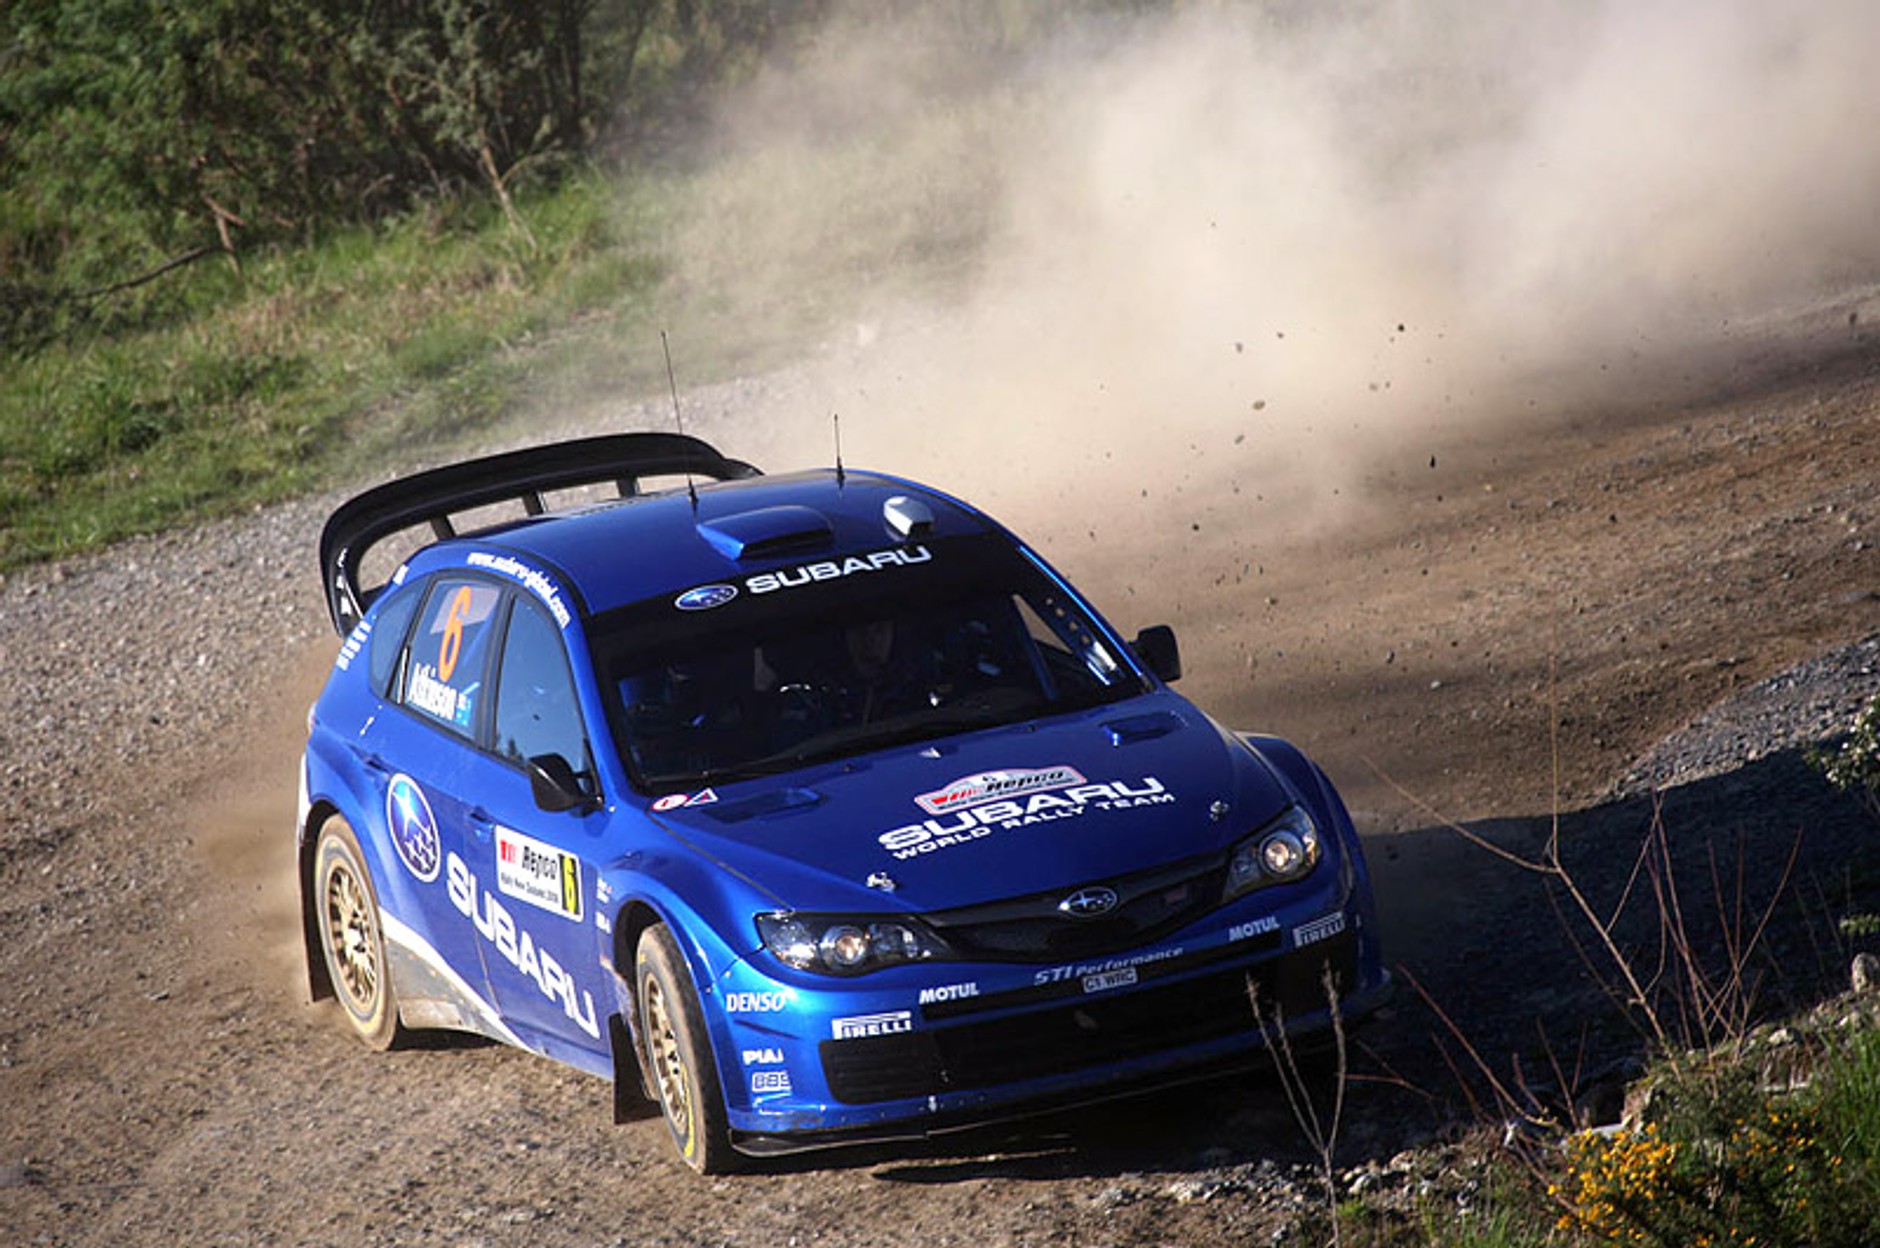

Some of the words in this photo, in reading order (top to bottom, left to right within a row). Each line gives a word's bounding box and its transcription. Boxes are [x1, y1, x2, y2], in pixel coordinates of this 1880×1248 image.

[745, 545, 932, 595] SUBARU
[438, 585, 471, 683] 6
[878, 777, 1166, 851] SUBARU
[893, 826, 992, 860] WORLD
[1001, 805, 1085, 830] RALLY
[1095, 793, 1175, 811] TEAM
[563, 855, 576, 914] 6
[447, 852, 600, 1038] SUBARU
[1229, 915, 1280, 941] MOTUL
[1292, 911, 1345, 948] PIRELLI
[1034, 966, 1072, 986] STI
[1075, 947, 1183, 977] Performance
[726, 991, 786, 1012] DENSO
[919, 982, 979, 1004] MOTUL
[832, 1010, 912, 1040] PIRELLI
